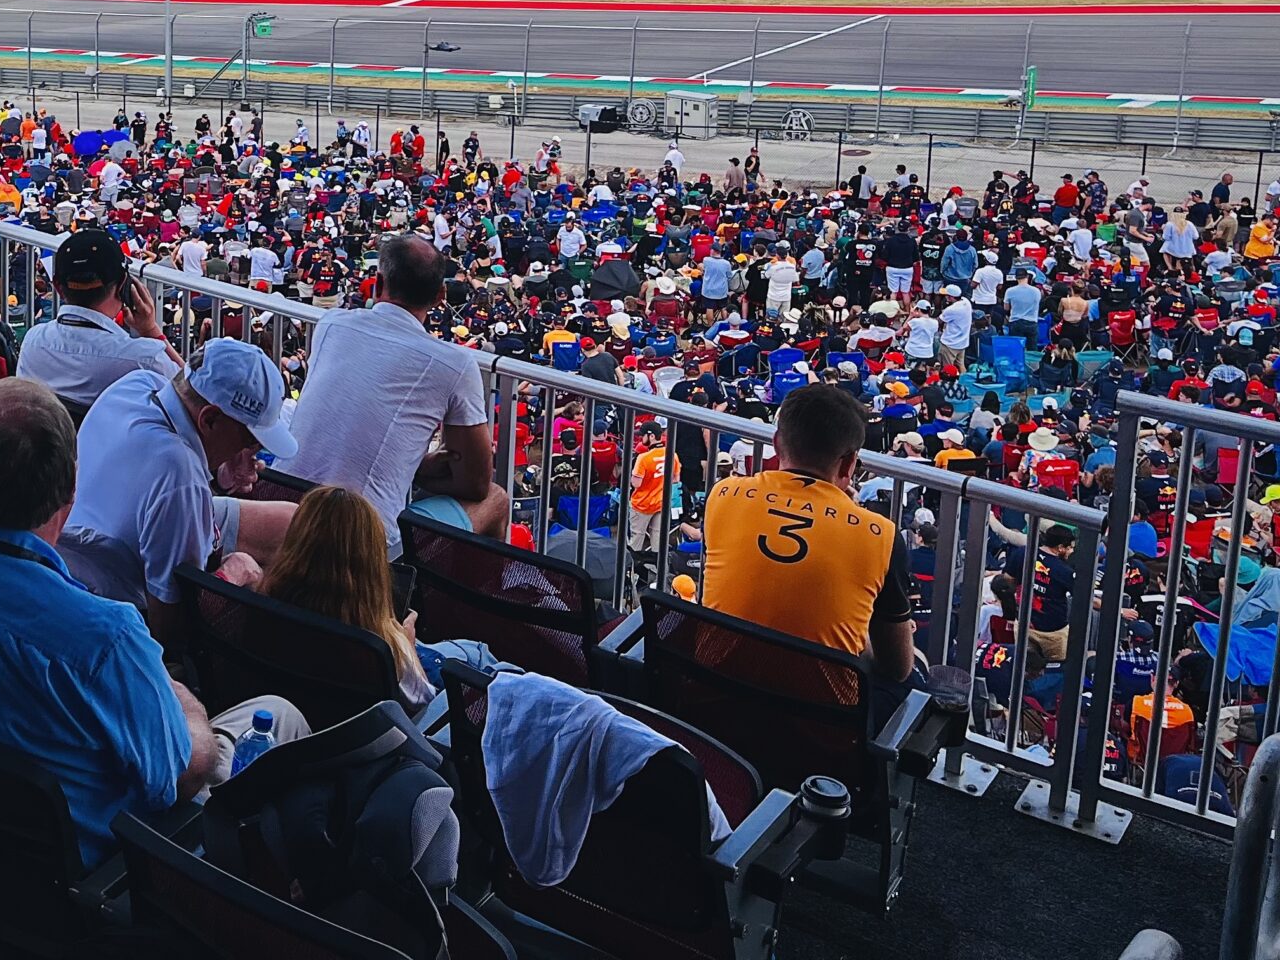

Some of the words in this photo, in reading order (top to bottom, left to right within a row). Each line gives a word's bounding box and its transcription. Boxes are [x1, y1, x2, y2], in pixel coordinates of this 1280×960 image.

[923, 249, 939, 259] 44
[718, 486, 882, 536] RICCIARDO
[758, 508, 814, 564] 3
